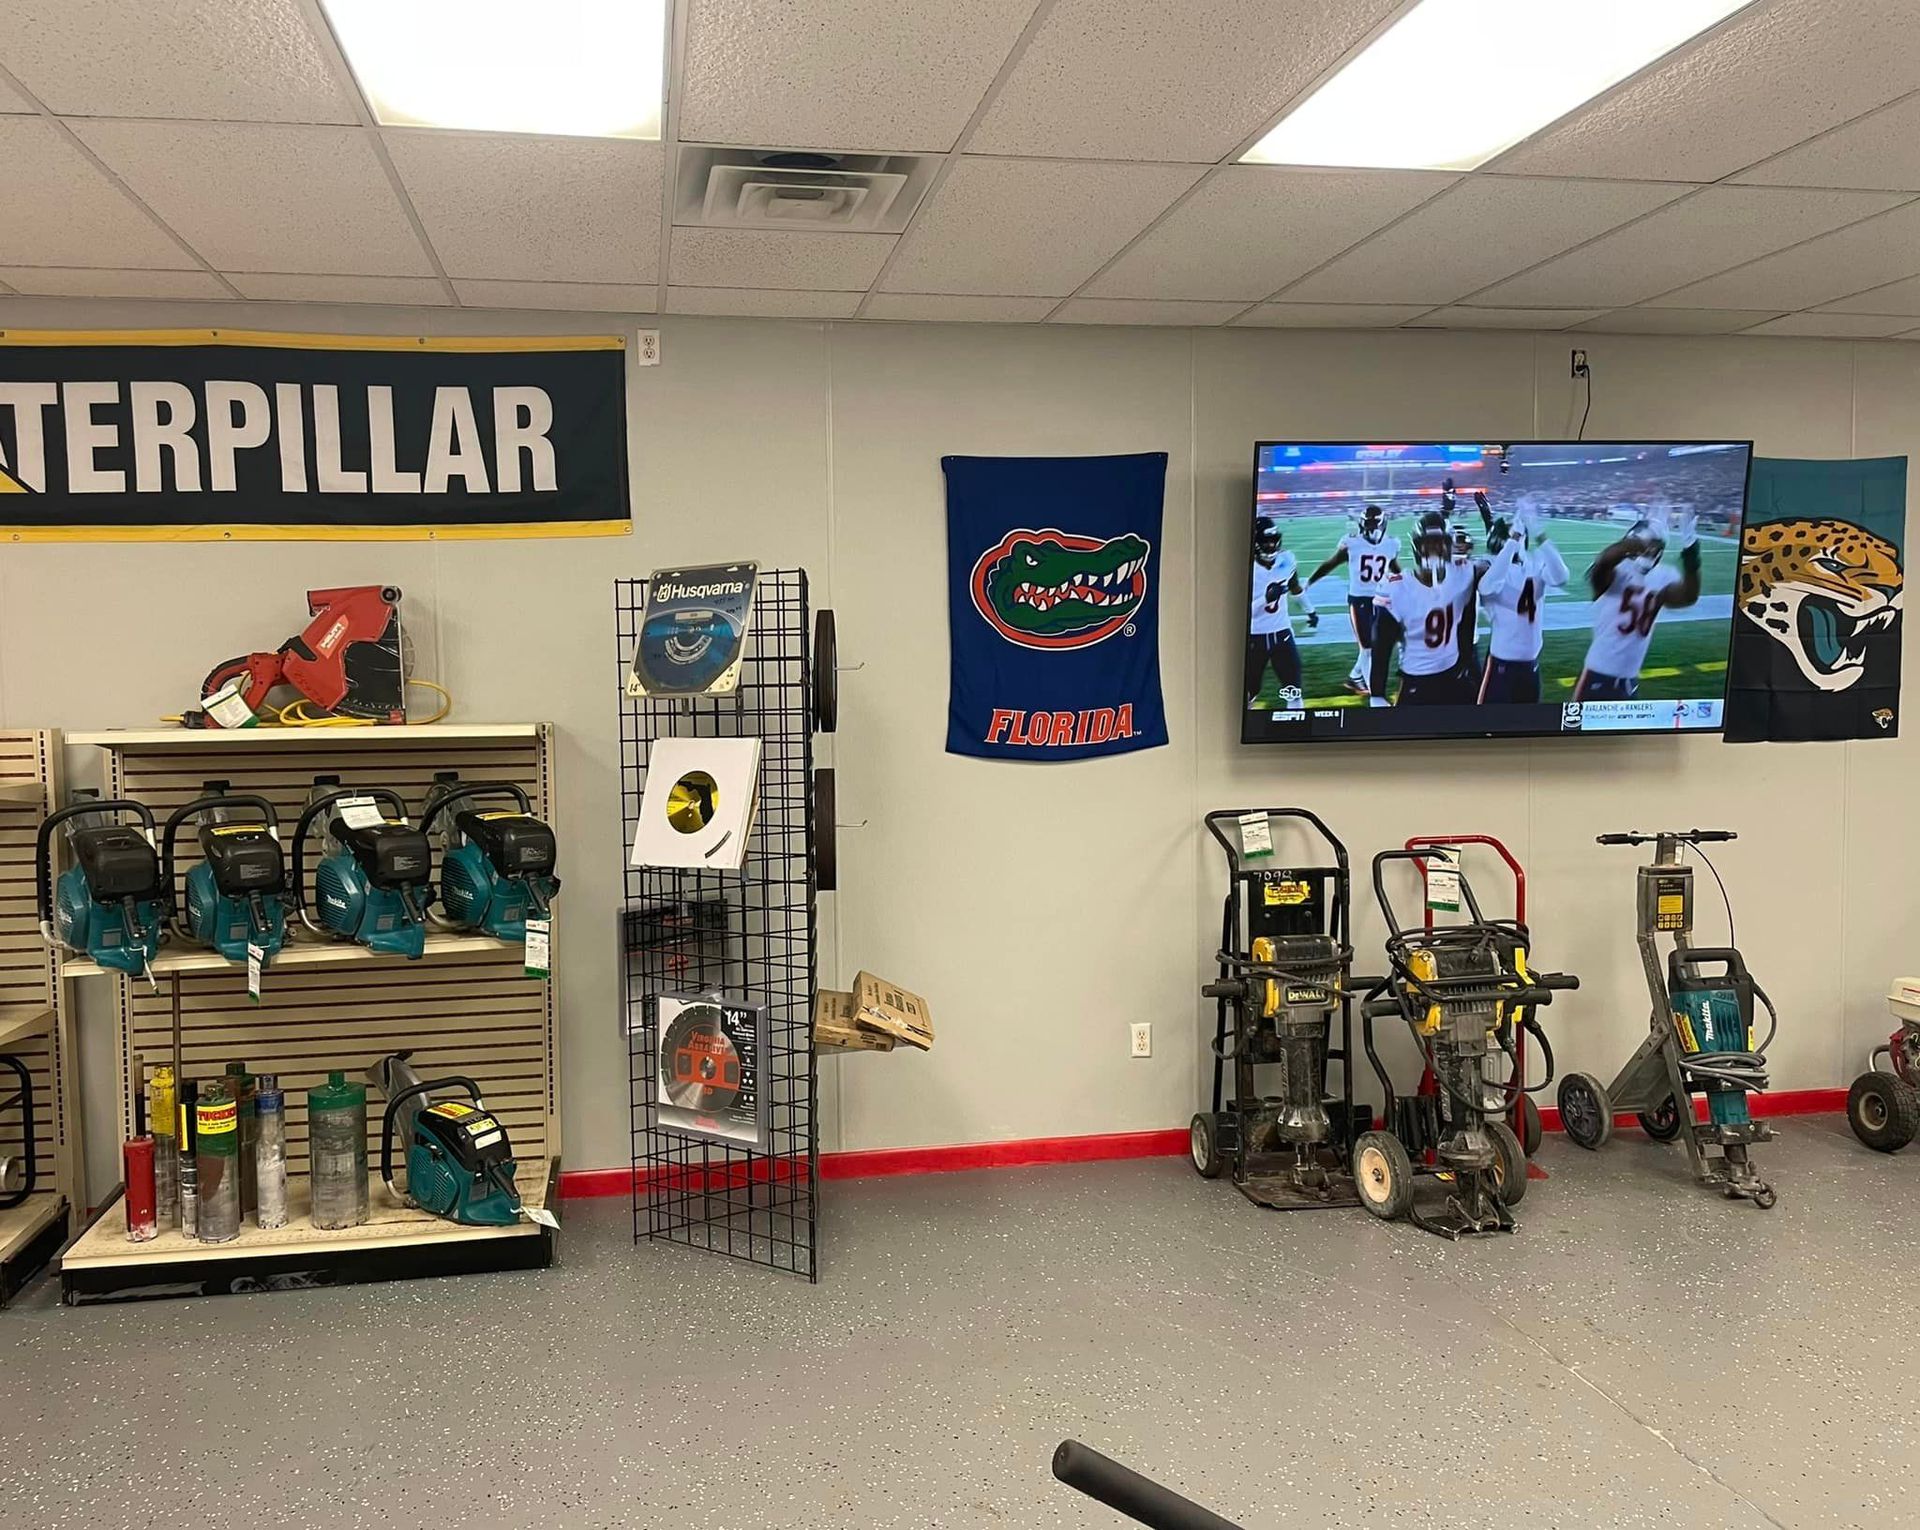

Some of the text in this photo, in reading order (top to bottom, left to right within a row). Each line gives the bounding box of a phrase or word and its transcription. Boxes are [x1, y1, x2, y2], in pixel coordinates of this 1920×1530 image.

[0, 381, 557, 494] TERPILLAR
[1360, 555, 1387, 582] 53
[671, 582, 743, 599] Husqvarna
[1517, 577, 1537, 623] 4
[1424, 602, 1453, 648] 91
[984, 703, 1133, 746] FLORIDA
[1272, 711, 1306, 722] ESPN
[1705, 1000, 1715, 1042] Makita
